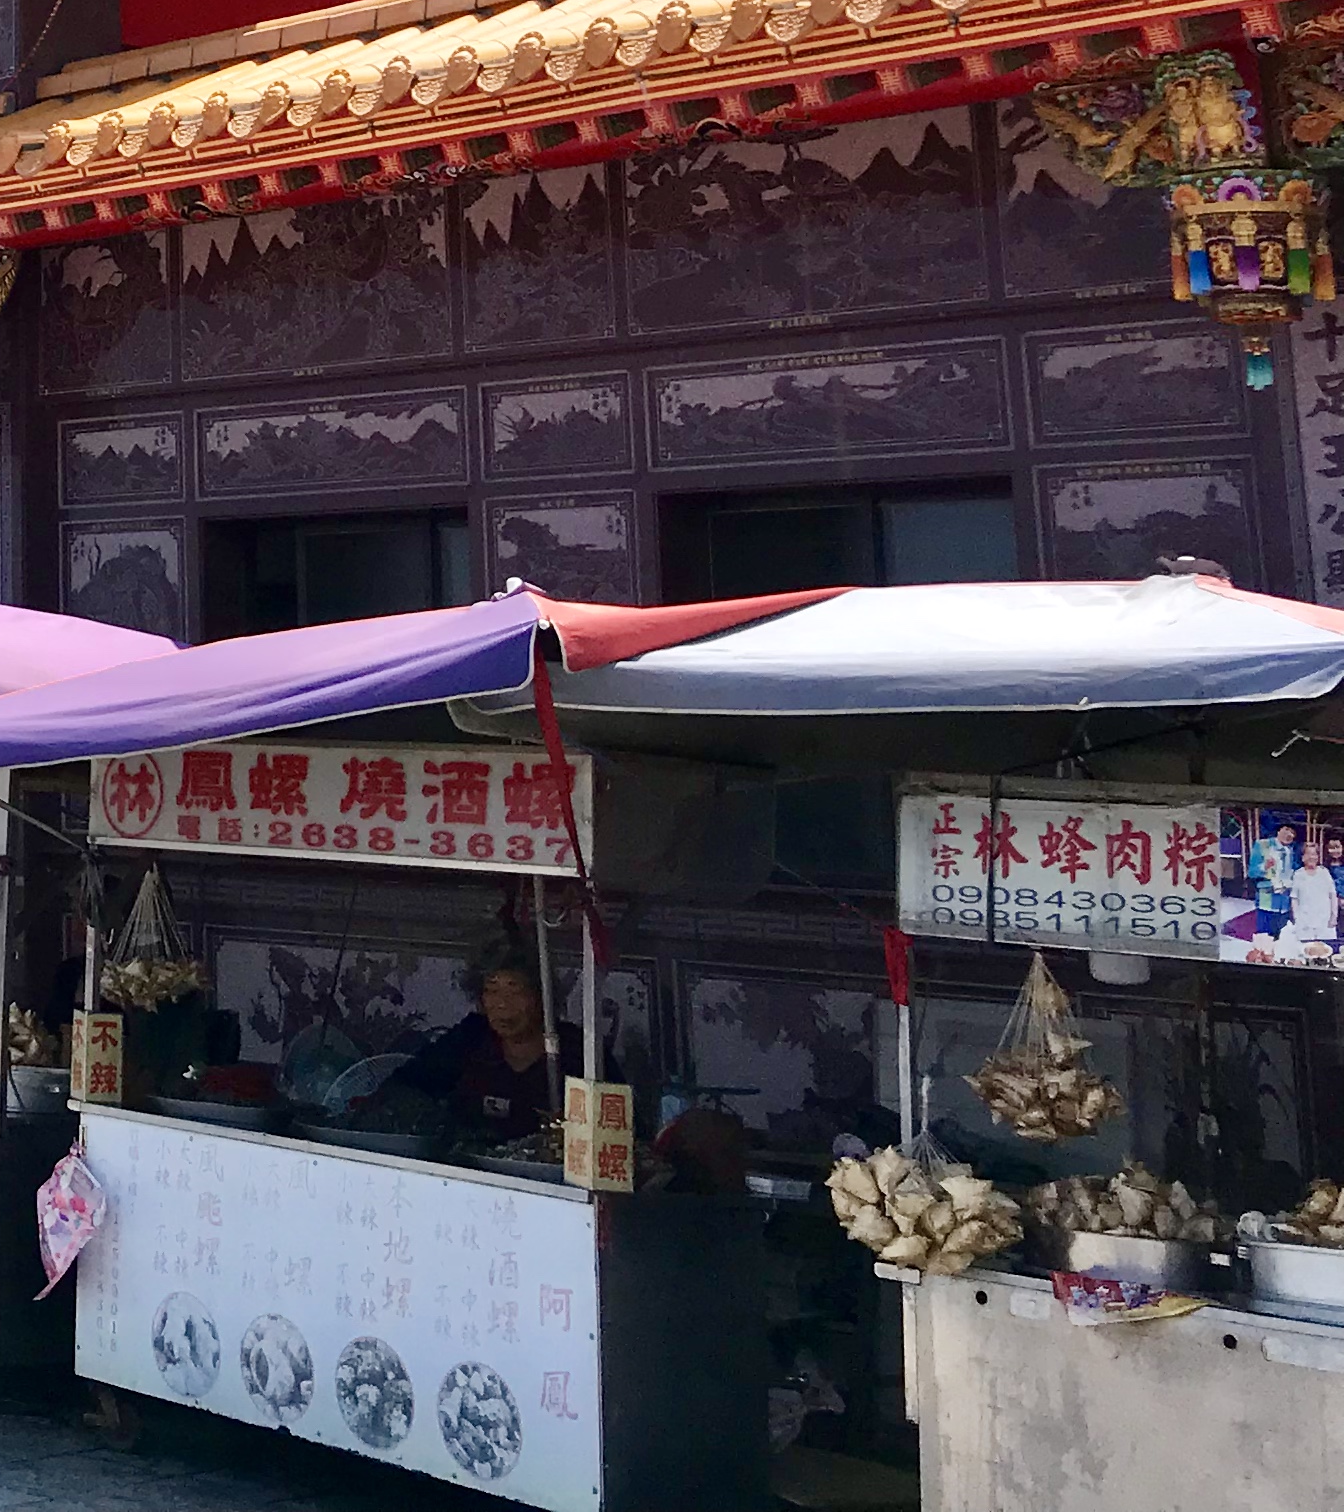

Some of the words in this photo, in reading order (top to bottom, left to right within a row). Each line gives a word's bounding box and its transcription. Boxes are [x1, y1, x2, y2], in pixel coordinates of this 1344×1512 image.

[109, 762, 157, 823] 林
[175, 751, 311, 817] 鳳螺
[930, 802, 964, 880] 正宗
[973, 810, 1219, 893] 林蜂肉粽
[931, 884, 1218, 917] 0908430363
[89, 1020, 119, 1094] 不辣
[597, 1092, 628, 1183] 鳳螺
